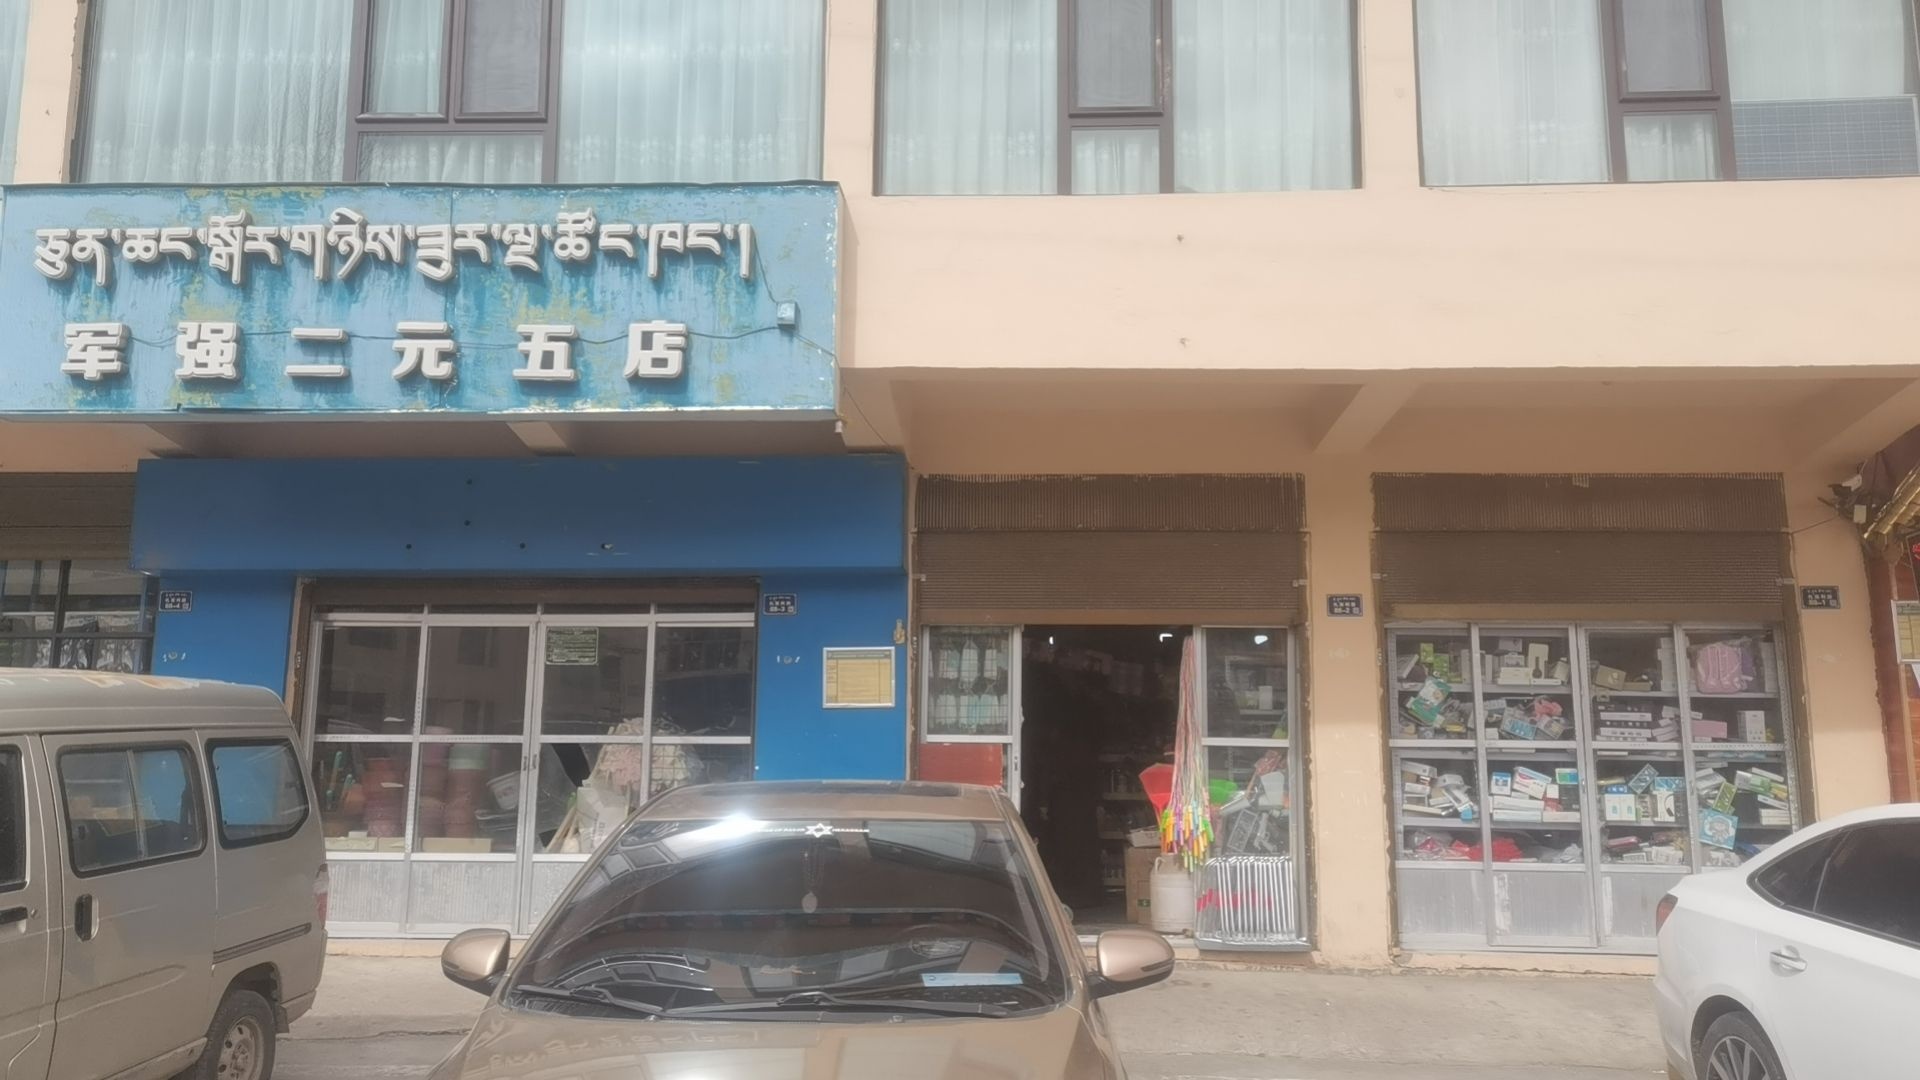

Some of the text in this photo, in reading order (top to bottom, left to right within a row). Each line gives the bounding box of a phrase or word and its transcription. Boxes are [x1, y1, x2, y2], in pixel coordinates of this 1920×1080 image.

[60, 319, 689, 381] 军强二元五店
